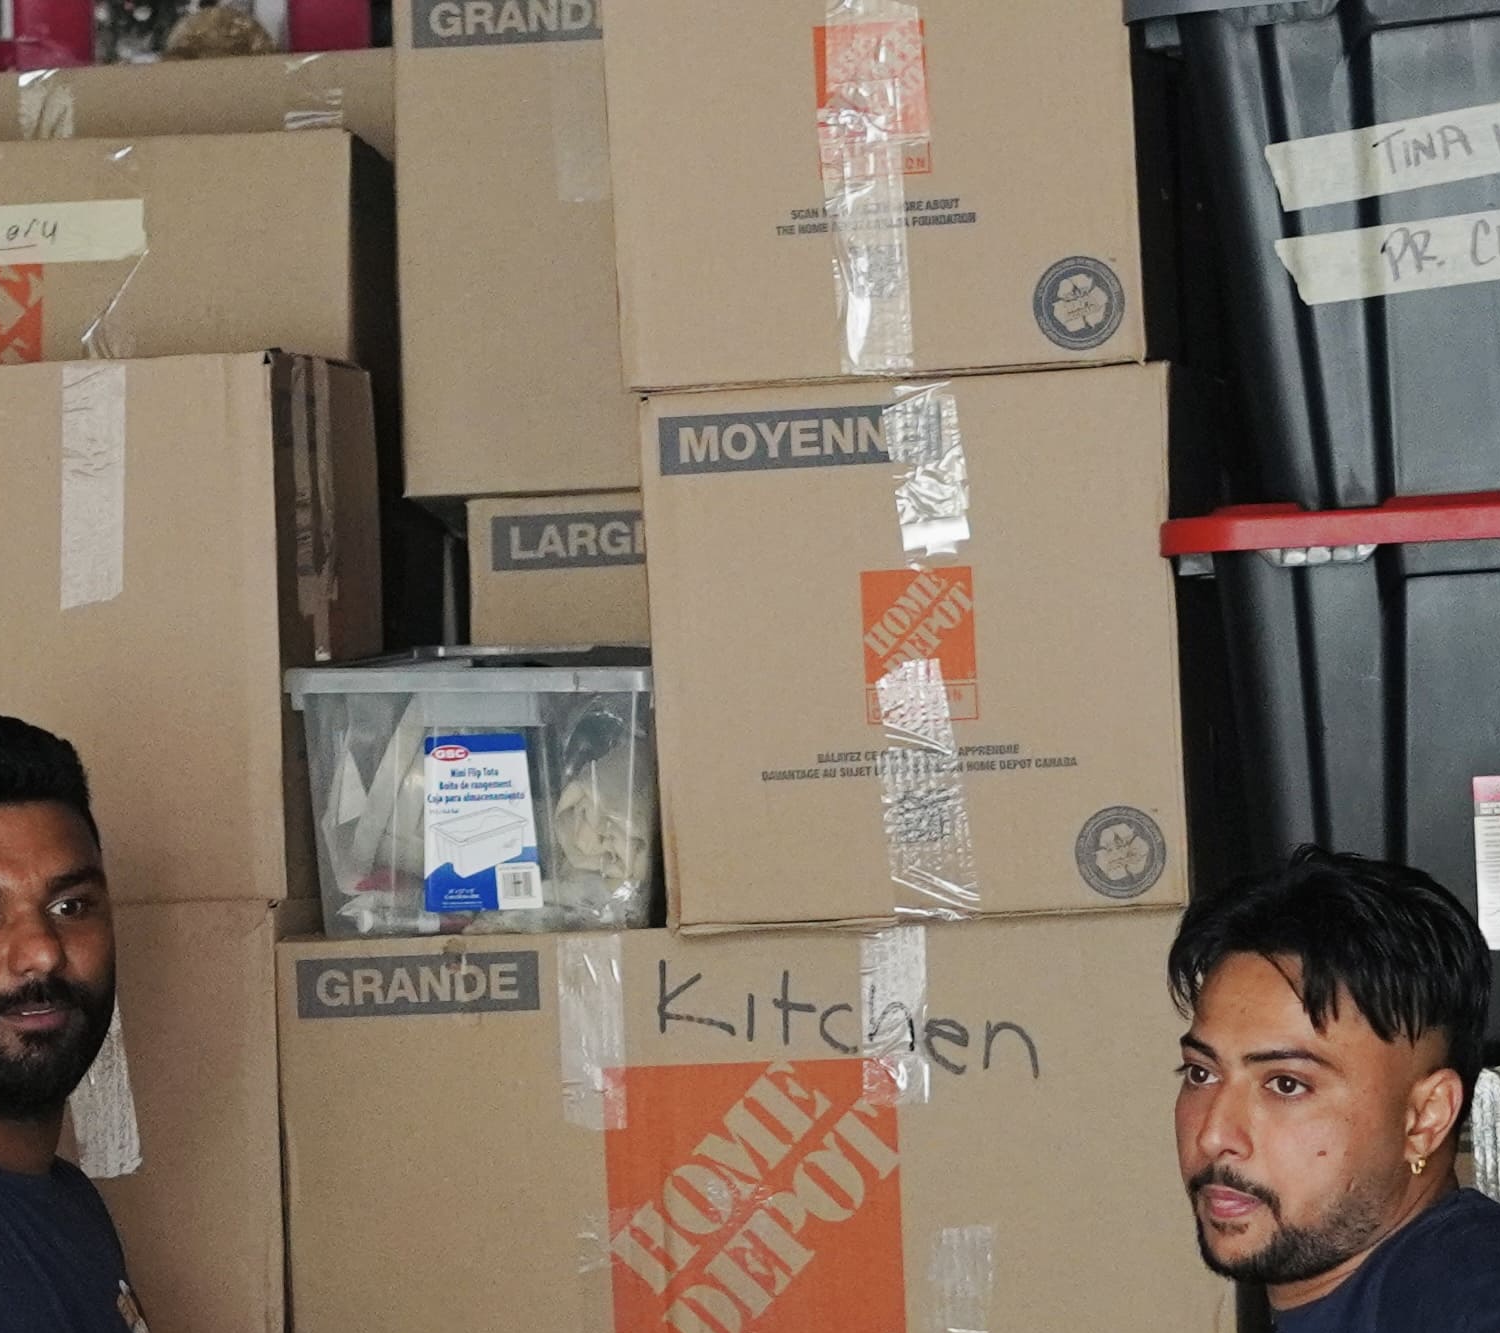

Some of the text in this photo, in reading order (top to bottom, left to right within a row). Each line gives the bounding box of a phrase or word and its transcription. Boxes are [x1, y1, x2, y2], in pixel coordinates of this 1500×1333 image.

[429, 0, 600, 38] GRAND
[1371, 125, 1474, 174] TINA
[678, 415, 889, 463] MOYENN
[509, 523, 645, 559] LARG
[864, 570, 949, 656] HOME
[315, 964, 519, 1006] GRANDE
[658, 960, 1040, 1080] Kitchen
[610, 1062, 830, 1294] HOME
